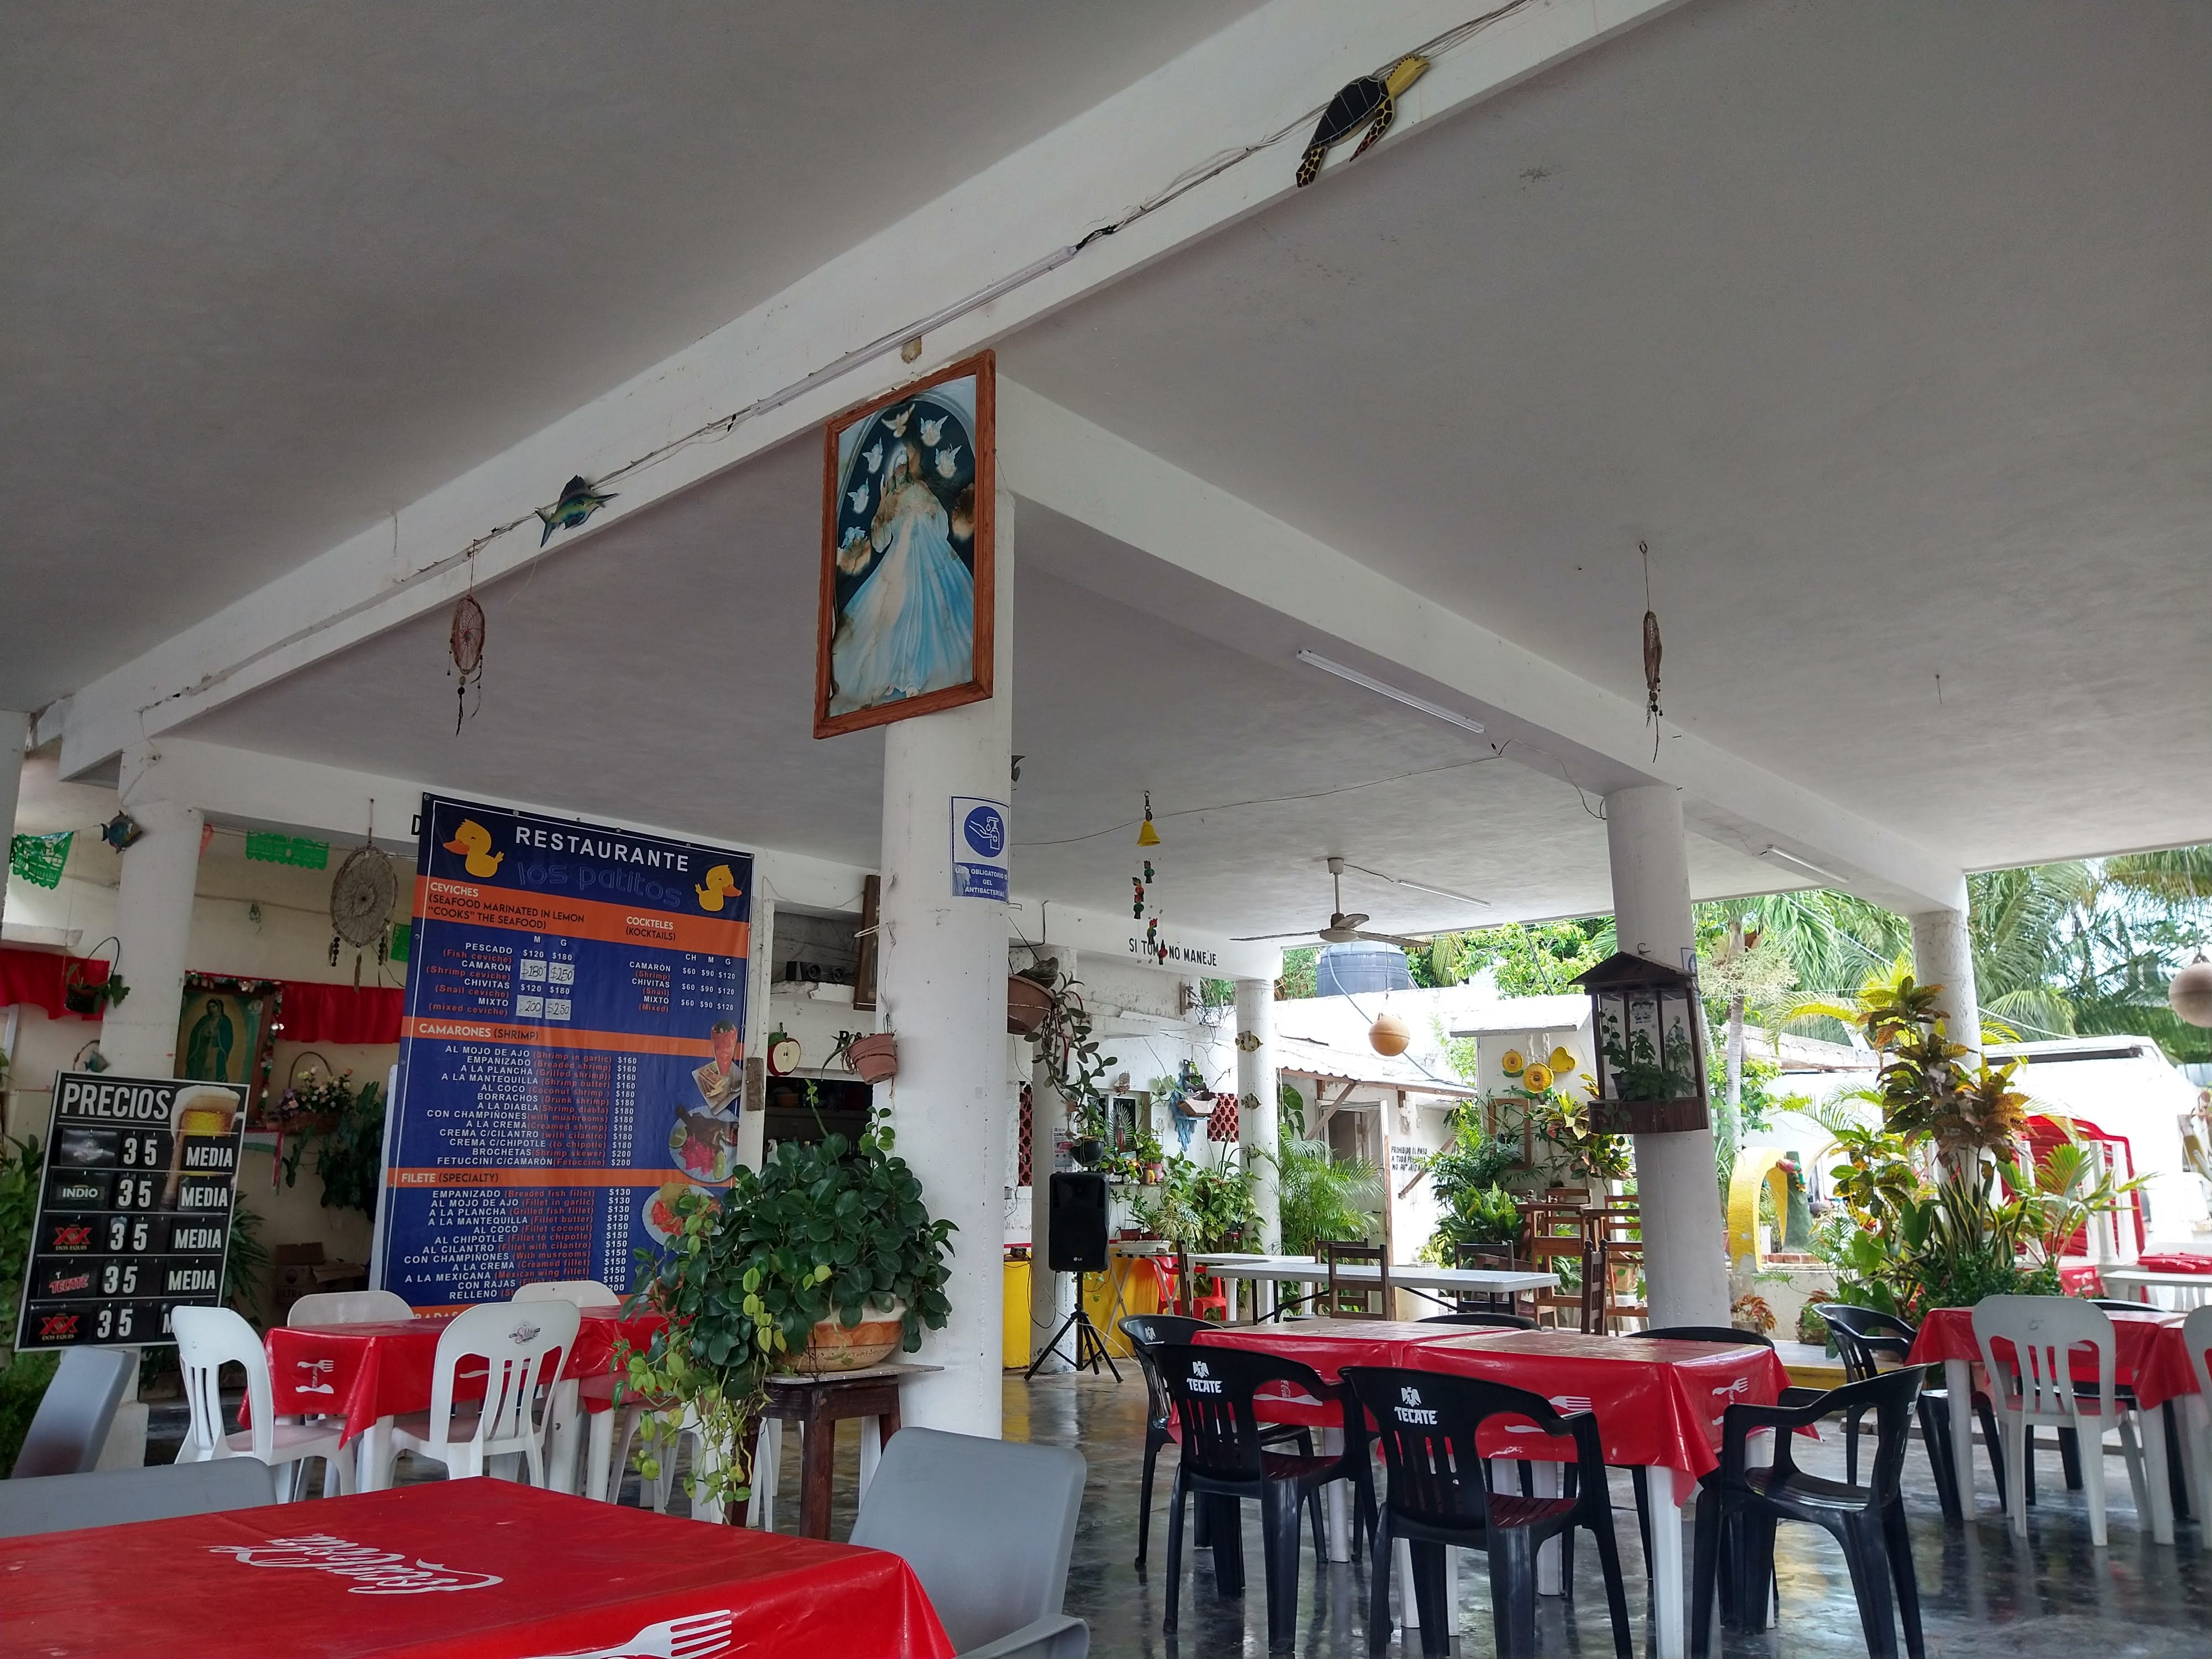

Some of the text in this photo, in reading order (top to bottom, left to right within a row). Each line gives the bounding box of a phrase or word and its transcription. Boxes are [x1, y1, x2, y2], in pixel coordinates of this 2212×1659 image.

[515, 826, 688, 872] RESTAURANTE
[971, 868, 1004, 879] OBLIGATORIO
[430, 882, 478, 897] CEVICHES
[518, 862, 682, 907] los patitos
[965, 887, 1005, 898] ANTIBACTERIAL
[429, 893, 585, 923] (SEAFOOD MARINATED IN LEMON
[477, 912, 495, 923] THE
[498, 915, 546, 930] SEAFOOD)
[626, 916, 674, 930] COCKTELES
[626, 926, 676, 941] (KOCKTAILS)
[466, 942, 572, 961] PESCADO $120 $180
[1129, 938, 1217, 967] SI TOM NO MANEJE
[462, 960, 511, 972] CAMARÓN
[629, 961, 670, 972] CAMARÓN
[465, 978, 570, 994] CHIVITAS $120 $180
[632, 977, 670, 988] CHIVITAS
[478, 998, 508, 1006] MIXTO
[419, 1023, 539, 1041] CAMARONES (SHRIMP)
[463, 1046, 491, 1055] MOJO
[467, 1056, 530, 1066] EMPANIZADO
[488, 1066, 533, 1075] PLANCHA
[469, 1074, 538, 1084] MANTEQUILLA
[61, 1083, 171, 1120] PRECIOS
[477, 1093, 538, 1102] BORRACHOS
[454, 1110, 526, 1119] CHAMPIÑONES
[1391, 1146, 1411, 1155] PROHIBIDO
[185, 1147, 233, 1168] MEDIA
[497, 1156, 552, 1165] C/CAMARÓN
[401, 1172, 499, 1183] FILETE (SPECIALTY)
[62, 1187, 98, 1198] INDIO
[181, 1186, 228, 1207] MEDIA
[458, 1208, 506, 1216] PLANCHA
[457, 1217, 528, 1225] MANTEQUILLA
[174, 1228, 222, 1249] MEDIA
[453, 1235, 504, 1243] CHIPOTLE
[441, 1244, 494, 1253] CILANTRO
[433, 1252, 509, 1262] CHAMPIÑONES
[605, 1249, 627, 1257] $150
[481, 1261, 514, 1270] CREMA
[604, 1258, 626, 1266] $150
[436, 1272, 491, 1281] MEXICANA
[604, 1266, 625, 1275] $150
[49, 1273, 90, 1294] TECATE
[168, 1269, 216, 1291] MEDIA
[458, 1281, 479, 1290] CON
[484, 1280, 515, 1288] RAJAS
[450, 1290, 497, 1299] RELLENO
[1186, 1378, 1222, 1394] TECATE
[1394, 1406, 1437, 1425] TECATE
